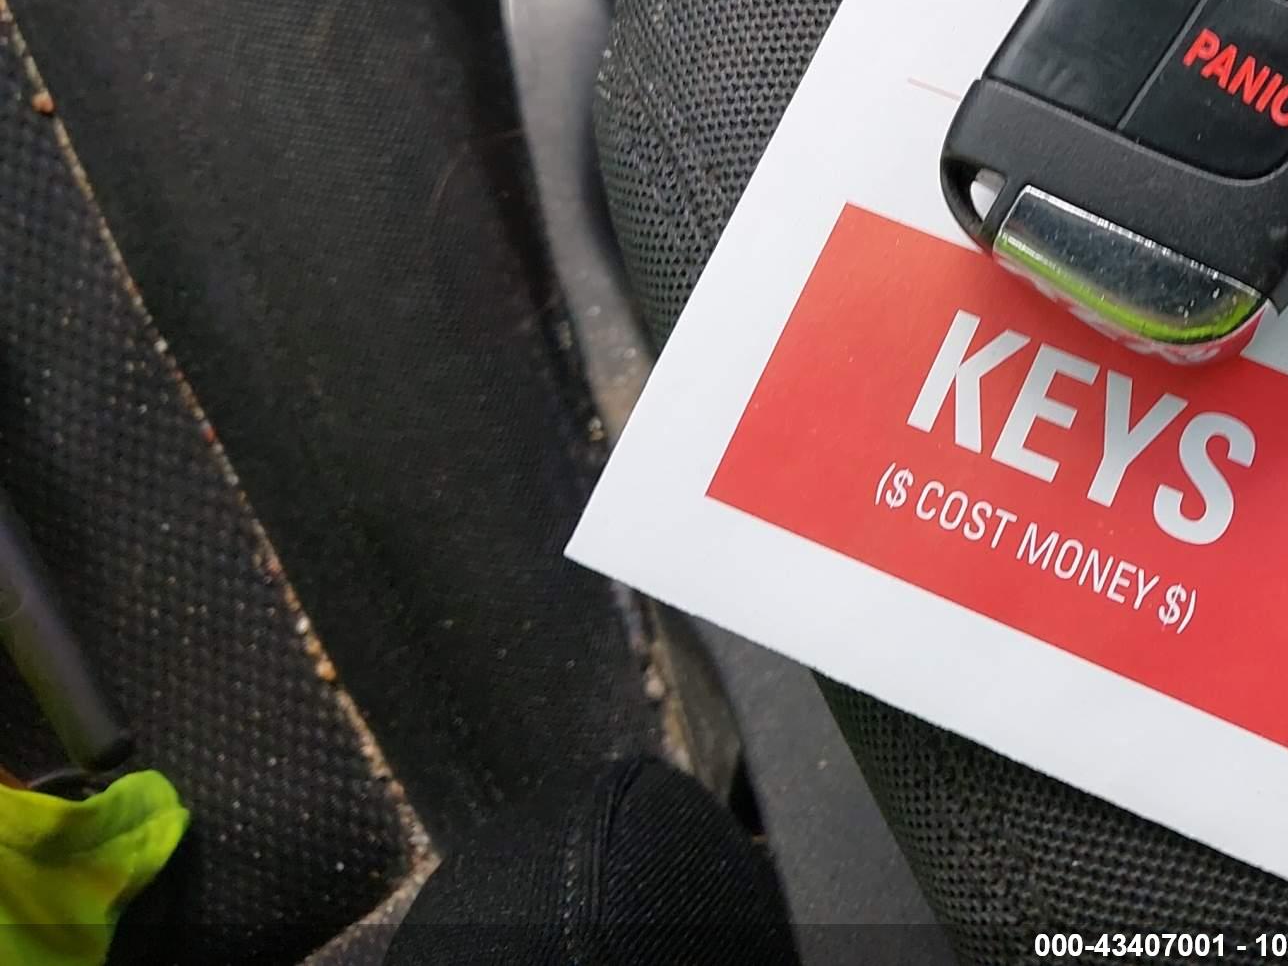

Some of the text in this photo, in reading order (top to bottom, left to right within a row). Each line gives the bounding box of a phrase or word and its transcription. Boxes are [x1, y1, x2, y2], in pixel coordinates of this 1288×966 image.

[906, 309, 1257, 545] KEYS
[875, 462, 1197, 635] ($ COST MONEY $)
